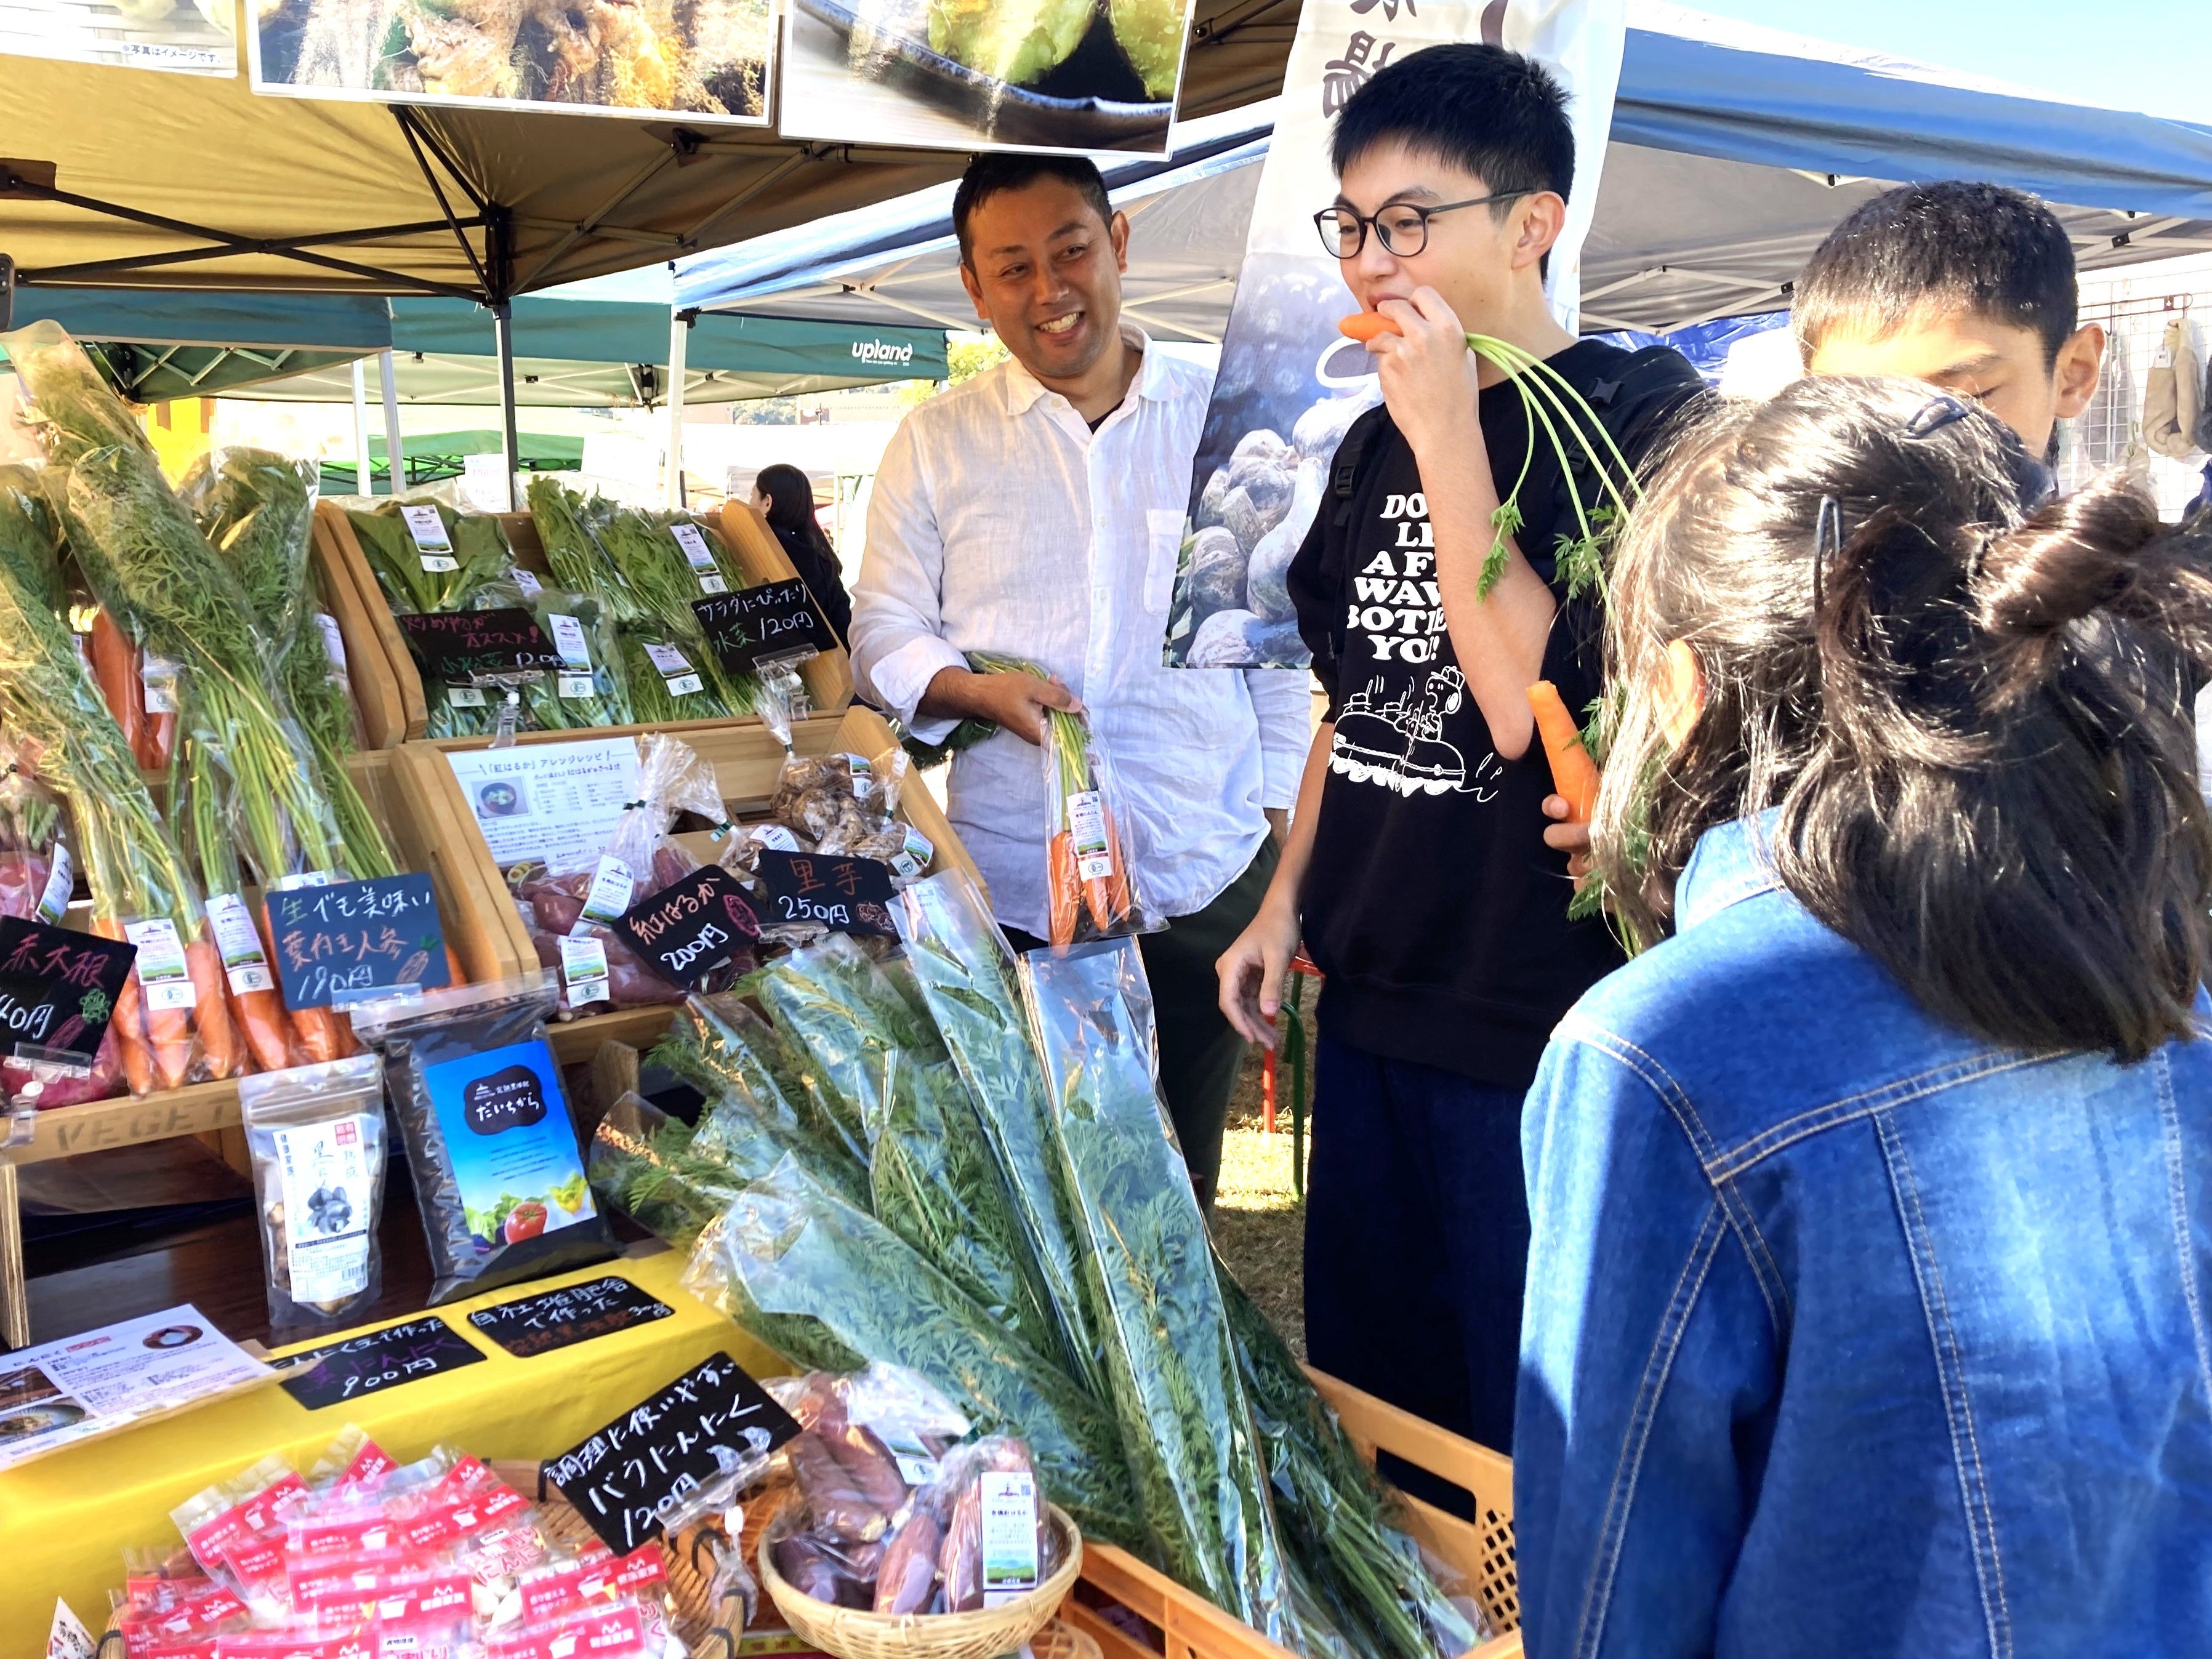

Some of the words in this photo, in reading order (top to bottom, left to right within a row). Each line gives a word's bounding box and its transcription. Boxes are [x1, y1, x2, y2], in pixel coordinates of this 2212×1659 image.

[123, 44, 220, 63] ※写真はイメージです。
[851, 339, 913, 363] upland
[1380, 492, 1429, 519] DO
[1362, 550, 1397, 576] A
[1403, 552, 1438, 577] F
[698, 583, 807, 622] サラダにぴったり
[1354, 576, 1441, 606] WAV
[714, 622, 757, 653] 水菜
[760, 611, 814, 640] 120円
[790, 858, 863, 896] 里芋
[281, 885, 431, 926] 生でも美味い
[629, 877, 721, 946] 紅はるか
[778, 895, 850, 925] 250円
[1, 933, 110, 988] 赤大根
[282, 925, 409, 973] 葉付き人参
[659, 922, 729, 971] 200円
[56, 1096, 238, 1151] VEGET
[475, 1091, 539, 1122] だいちから
[523, 1298, 621, 1329] で作った
[342, 1357, 437, 1397] 900円
[544, 1361, 736, 1488] 調理に使いやすい
[588, 1393, 763, 1516] バラにんにく
[623, 1472, 701, 1548] 120円
